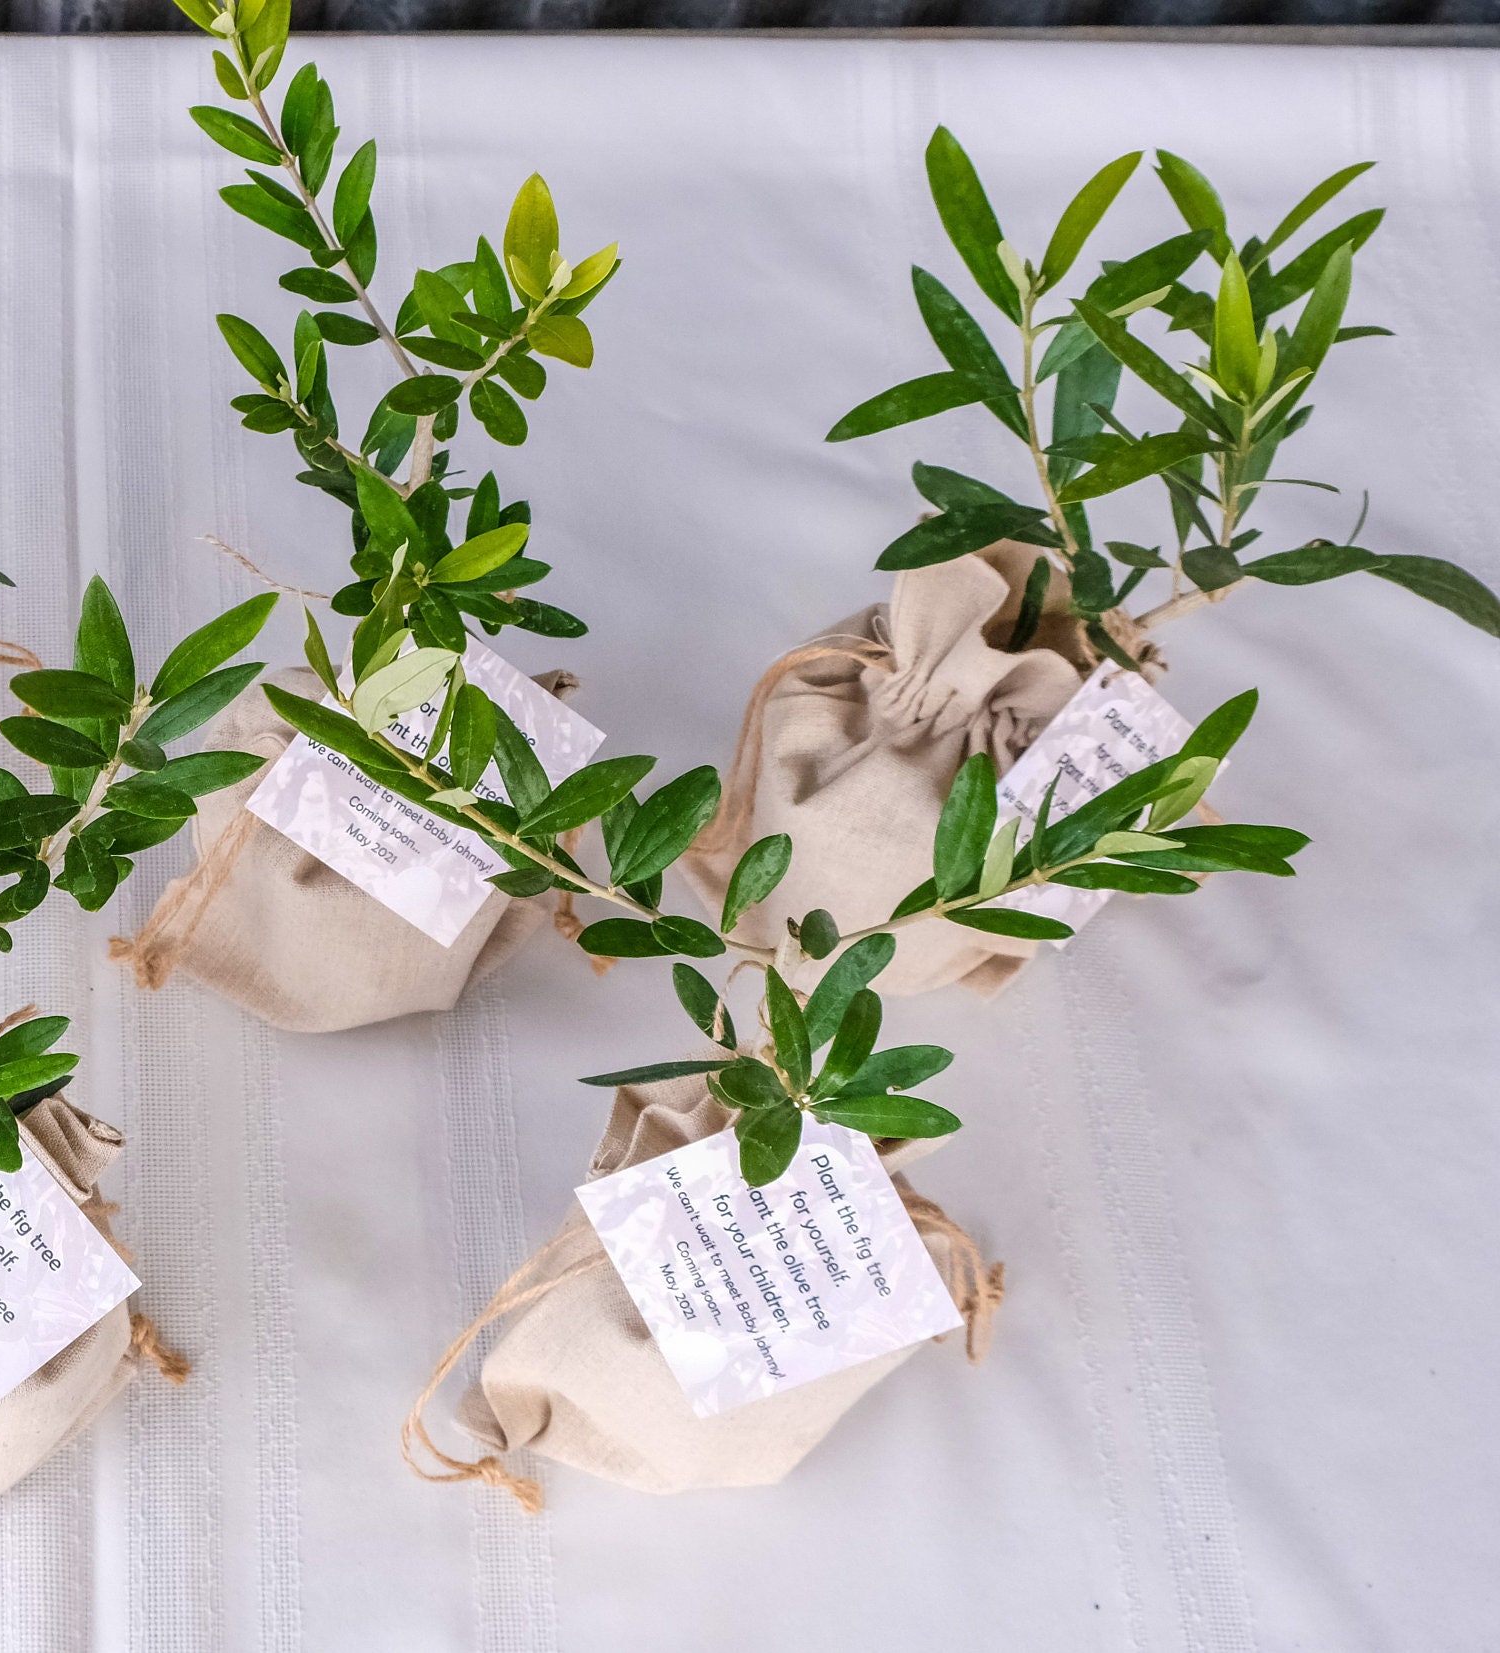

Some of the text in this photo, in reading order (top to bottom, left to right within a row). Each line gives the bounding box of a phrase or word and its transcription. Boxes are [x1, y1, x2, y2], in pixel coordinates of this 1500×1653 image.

[412, 734, 429, 754] th
[420, 702, 438, 717] or
[327, 750, 355, 776] can't
[356, 767, 381, 794] wait
[380, 792, 393, 808] to
[394, 799, 426, 825] meet
[424, 819, 452, 846] Baby
[452, 840, 494, 874] Johnny!
[346, 823, 399, 865] May 2021
[348, 795, 421, 854] Coming soon...
[10, 1209, 32, 1236] fig
[30, 1233, 61, 1272] tree
[712, 1194, 792, 1333] for your children.
[747, 1186, 830, 1331] ant the olive tree
[789, 1190, 851, 1288] for yourself.
[810, 1154, 891, 1297] Plant the fig tree
[659, 1263, 698, 1320] May 2021
[666, 1166, 786, 1380] We can't wait to meet Baby Johnny!
[676, 1240, 722, 1326] Coming soon...
